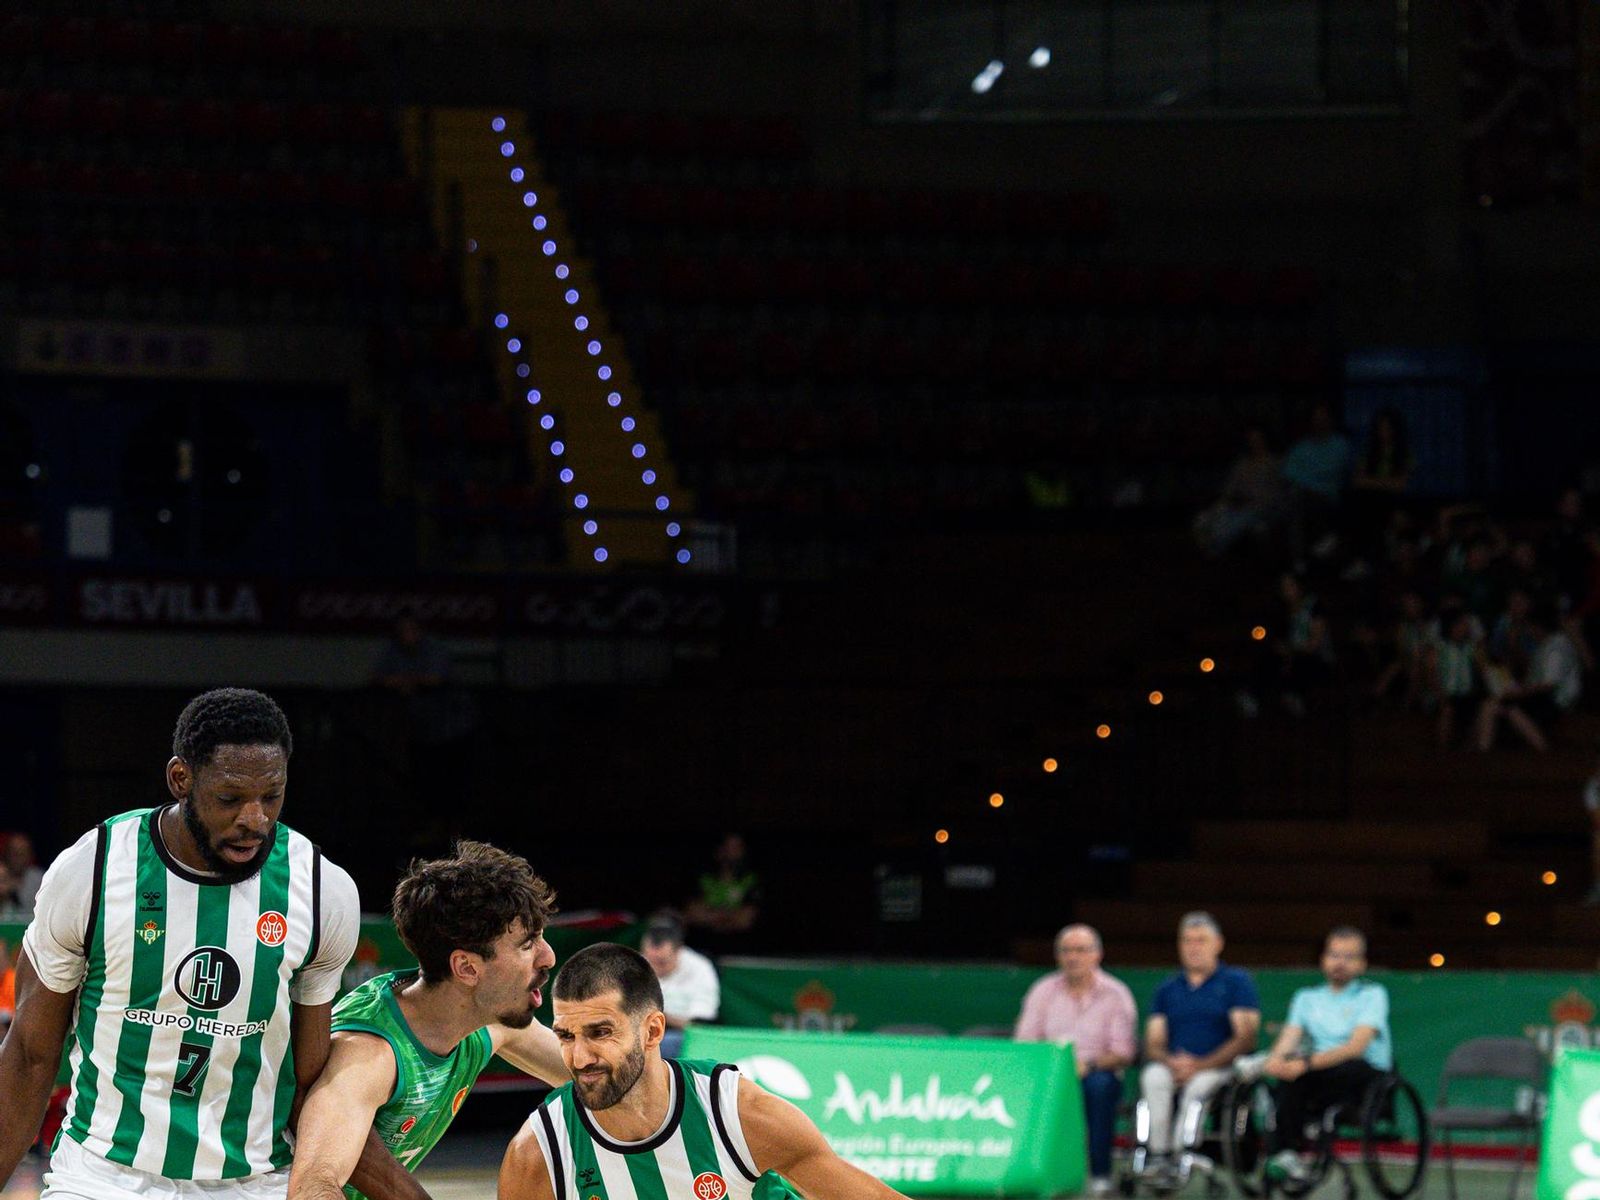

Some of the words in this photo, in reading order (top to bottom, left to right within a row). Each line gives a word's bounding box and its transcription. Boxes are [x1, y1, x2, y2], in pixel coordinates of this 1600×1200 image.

[80, 578, 261, 623] SEVILLA
[125, 1008, 193, 1029] GRUPO
[198, 1018, 267, 1037] HEREDA
[173, 1041, 213, 1097] 7
